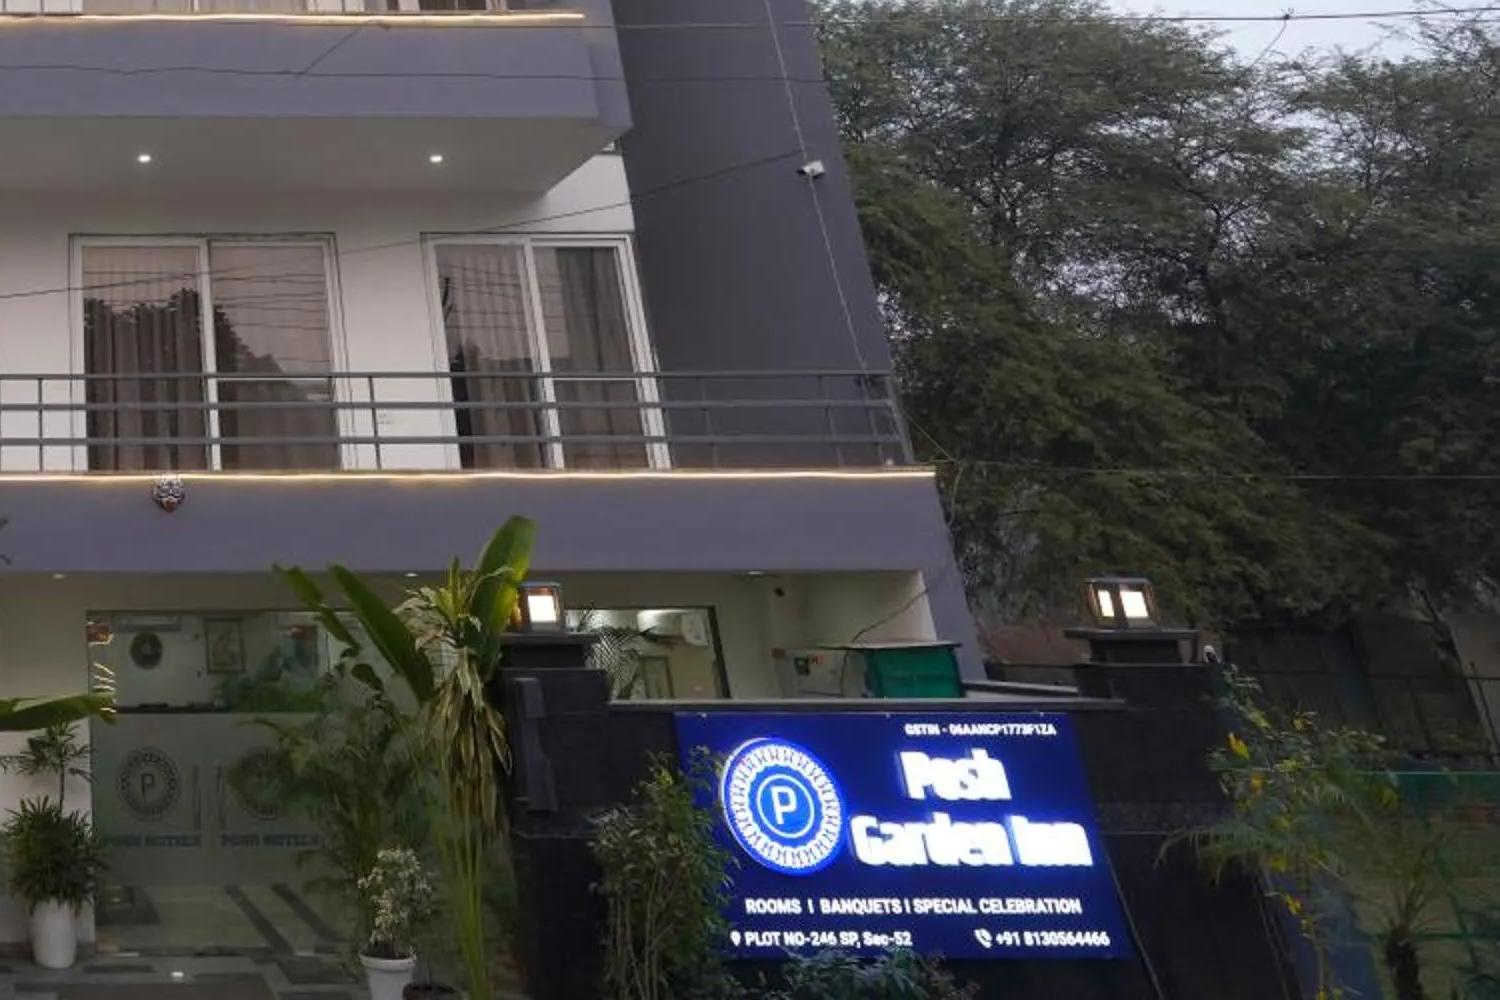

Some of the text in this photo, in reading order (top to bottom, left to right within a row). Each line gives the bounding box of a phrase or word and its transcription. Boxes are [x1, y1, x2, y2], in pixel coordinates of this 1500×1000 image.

[903, 723, 940, 736] GSTIN
[899, 748, 1012, 801] Posh
[772, 786, 798, 825] P
[850, 812, 1094, 867] Garden Inn
[745, 898, 802, 915] ROOMS
[820, 897, 901, 916] BANQUETS
[914, 898, 977, 916] SPECIAL
[979, 898, 1083, 915] CELEBRATION
[744, 930, 913, 949] PLOT NO-246 SP, Sec-52
[995, 930, 1111, 947] +91 8130564466
